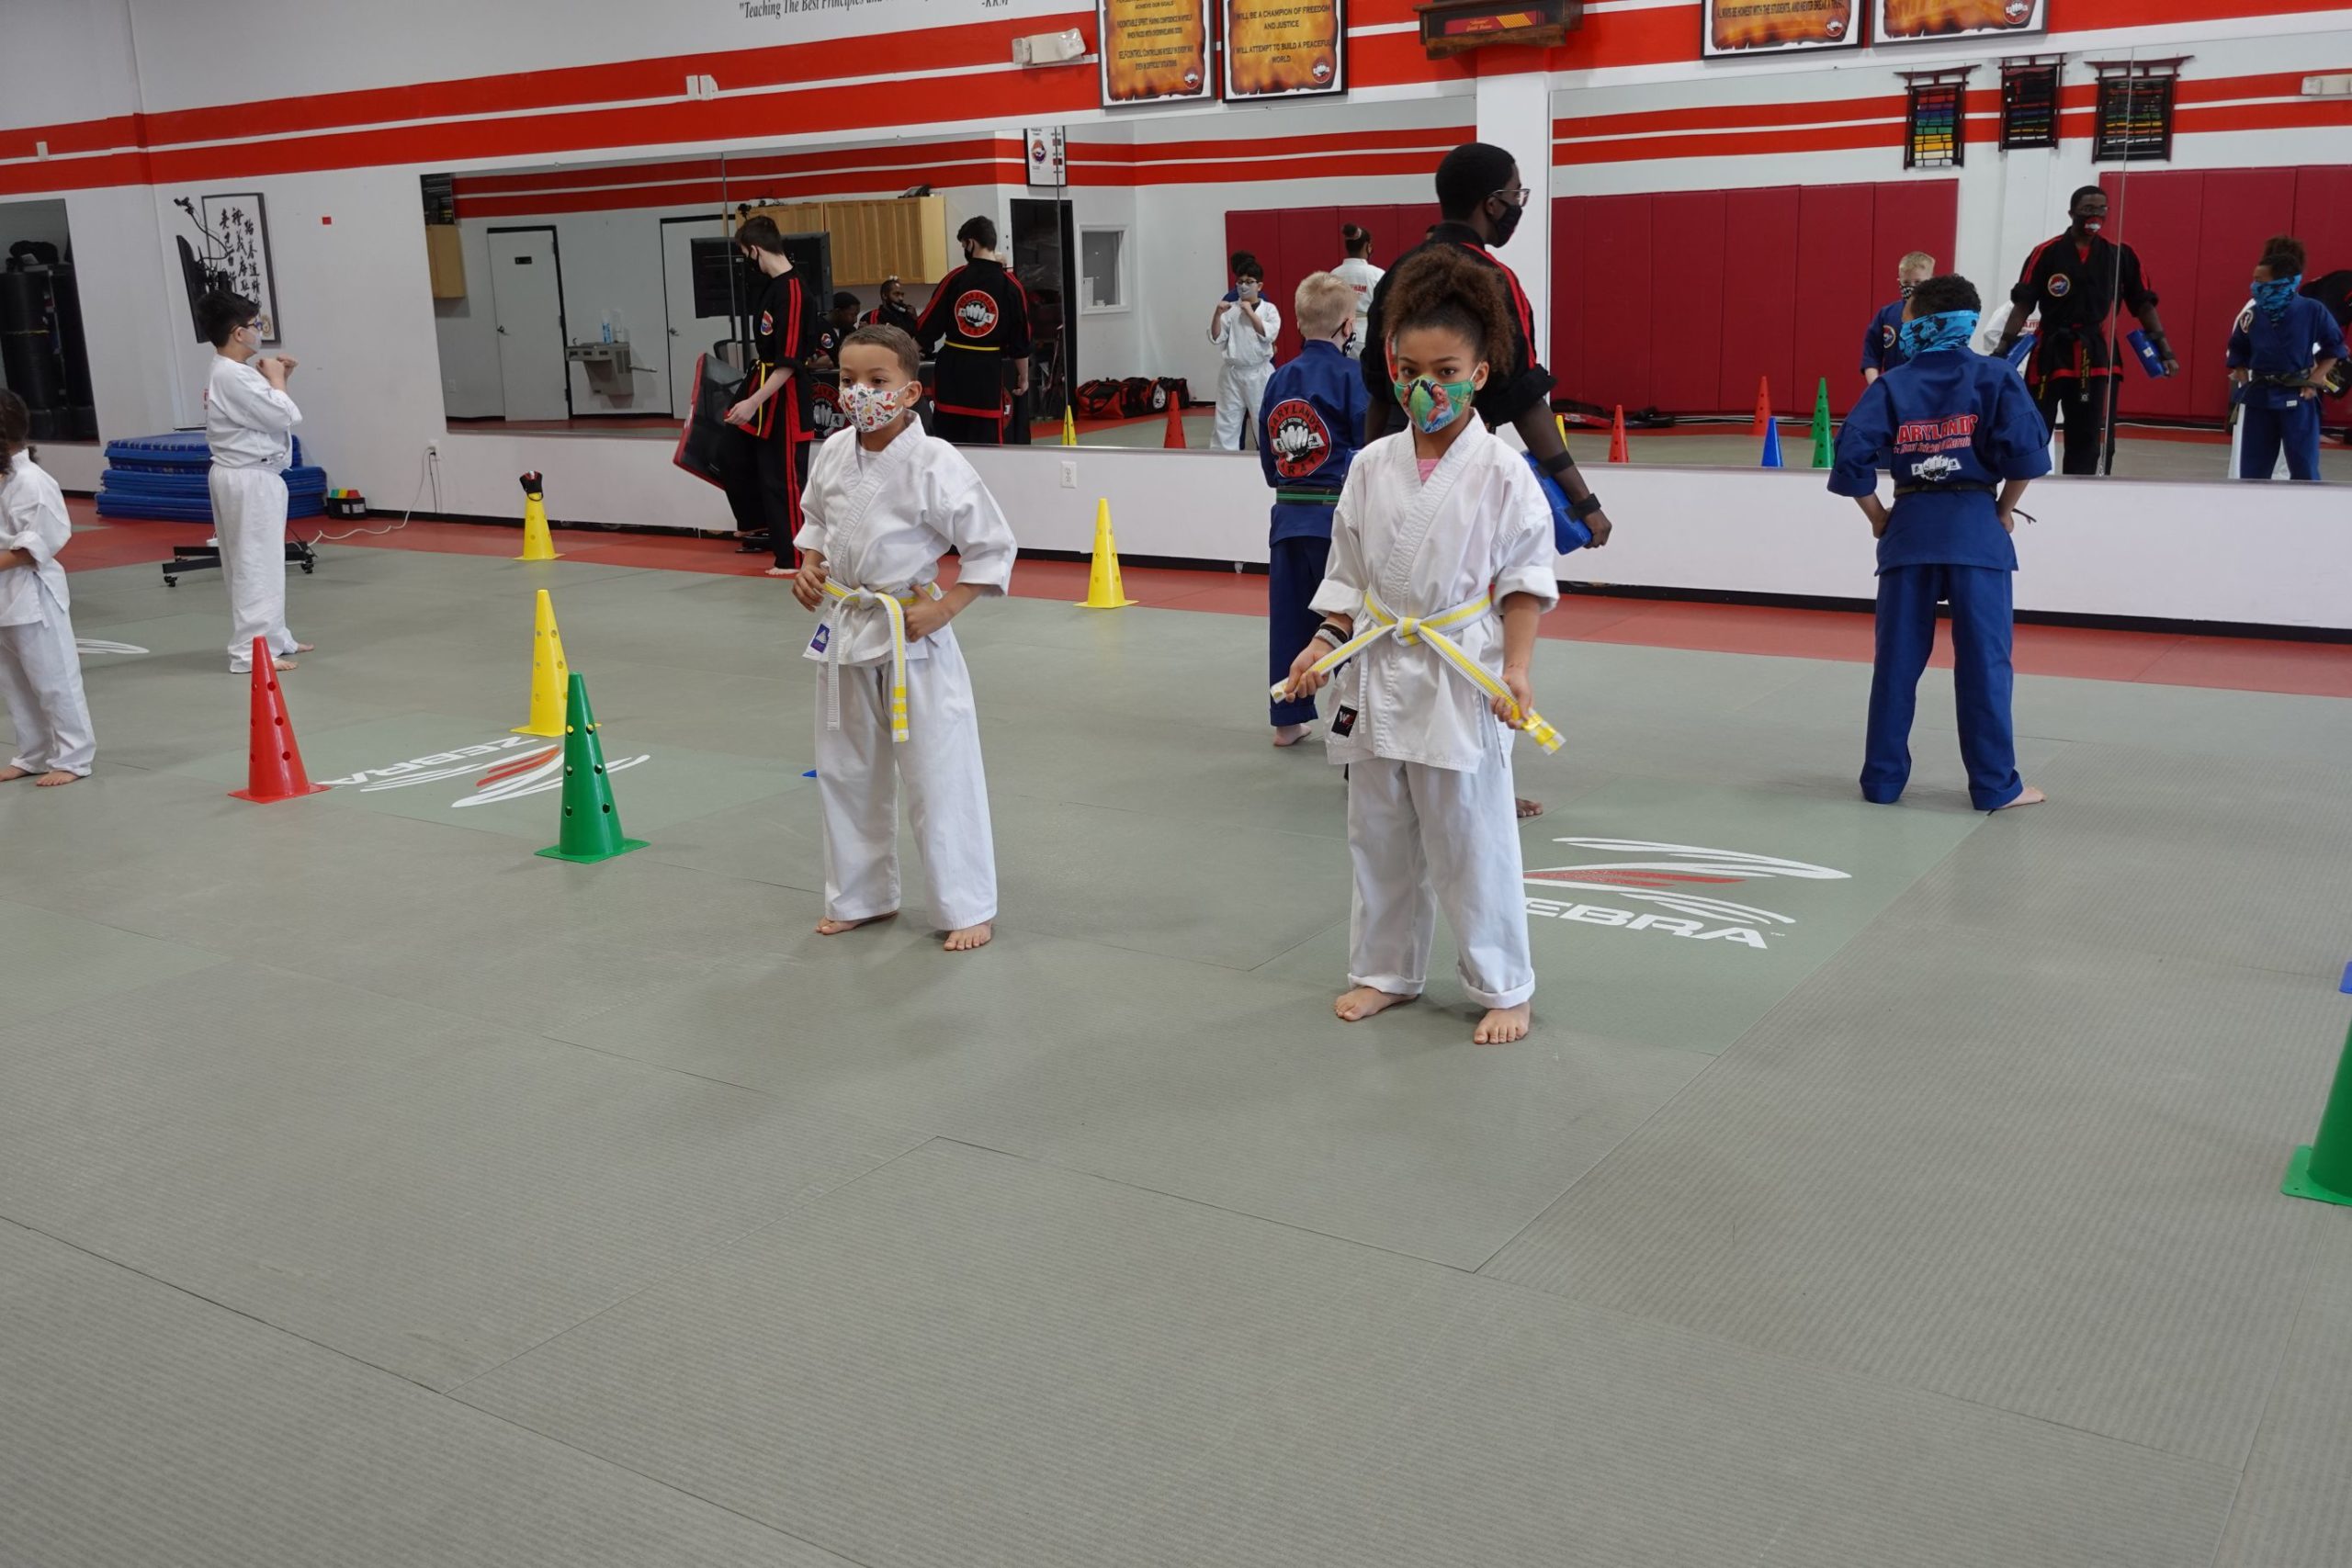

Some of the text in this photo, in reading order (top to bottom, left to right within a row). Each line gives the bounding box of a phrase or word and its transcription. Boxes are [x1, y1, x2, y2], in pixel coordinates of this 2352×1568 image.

[739, 2, 781, 19] "Teaching
[784, 0, 803, 14] The
[1250, 11, 1258, 19] BE
[1263, 7, 1293, 18] CHAMPION
[1293, 6, 1301, 15] OF
[1302, 5, 1330, 14] FREEDOM
[1263, 19, 1300, 30] AND JUSTICE
[1250, 44, 1272, 53] ATTEMPT
[1272, 43, 1281, 51] TO
[1281, 42, 1297, 51] BUILD
[1272, 55, 1291, 63] WORLD
[315, 737, 539, 786] ZEBRA
[1525, 897, 1768, 949] EBRA
